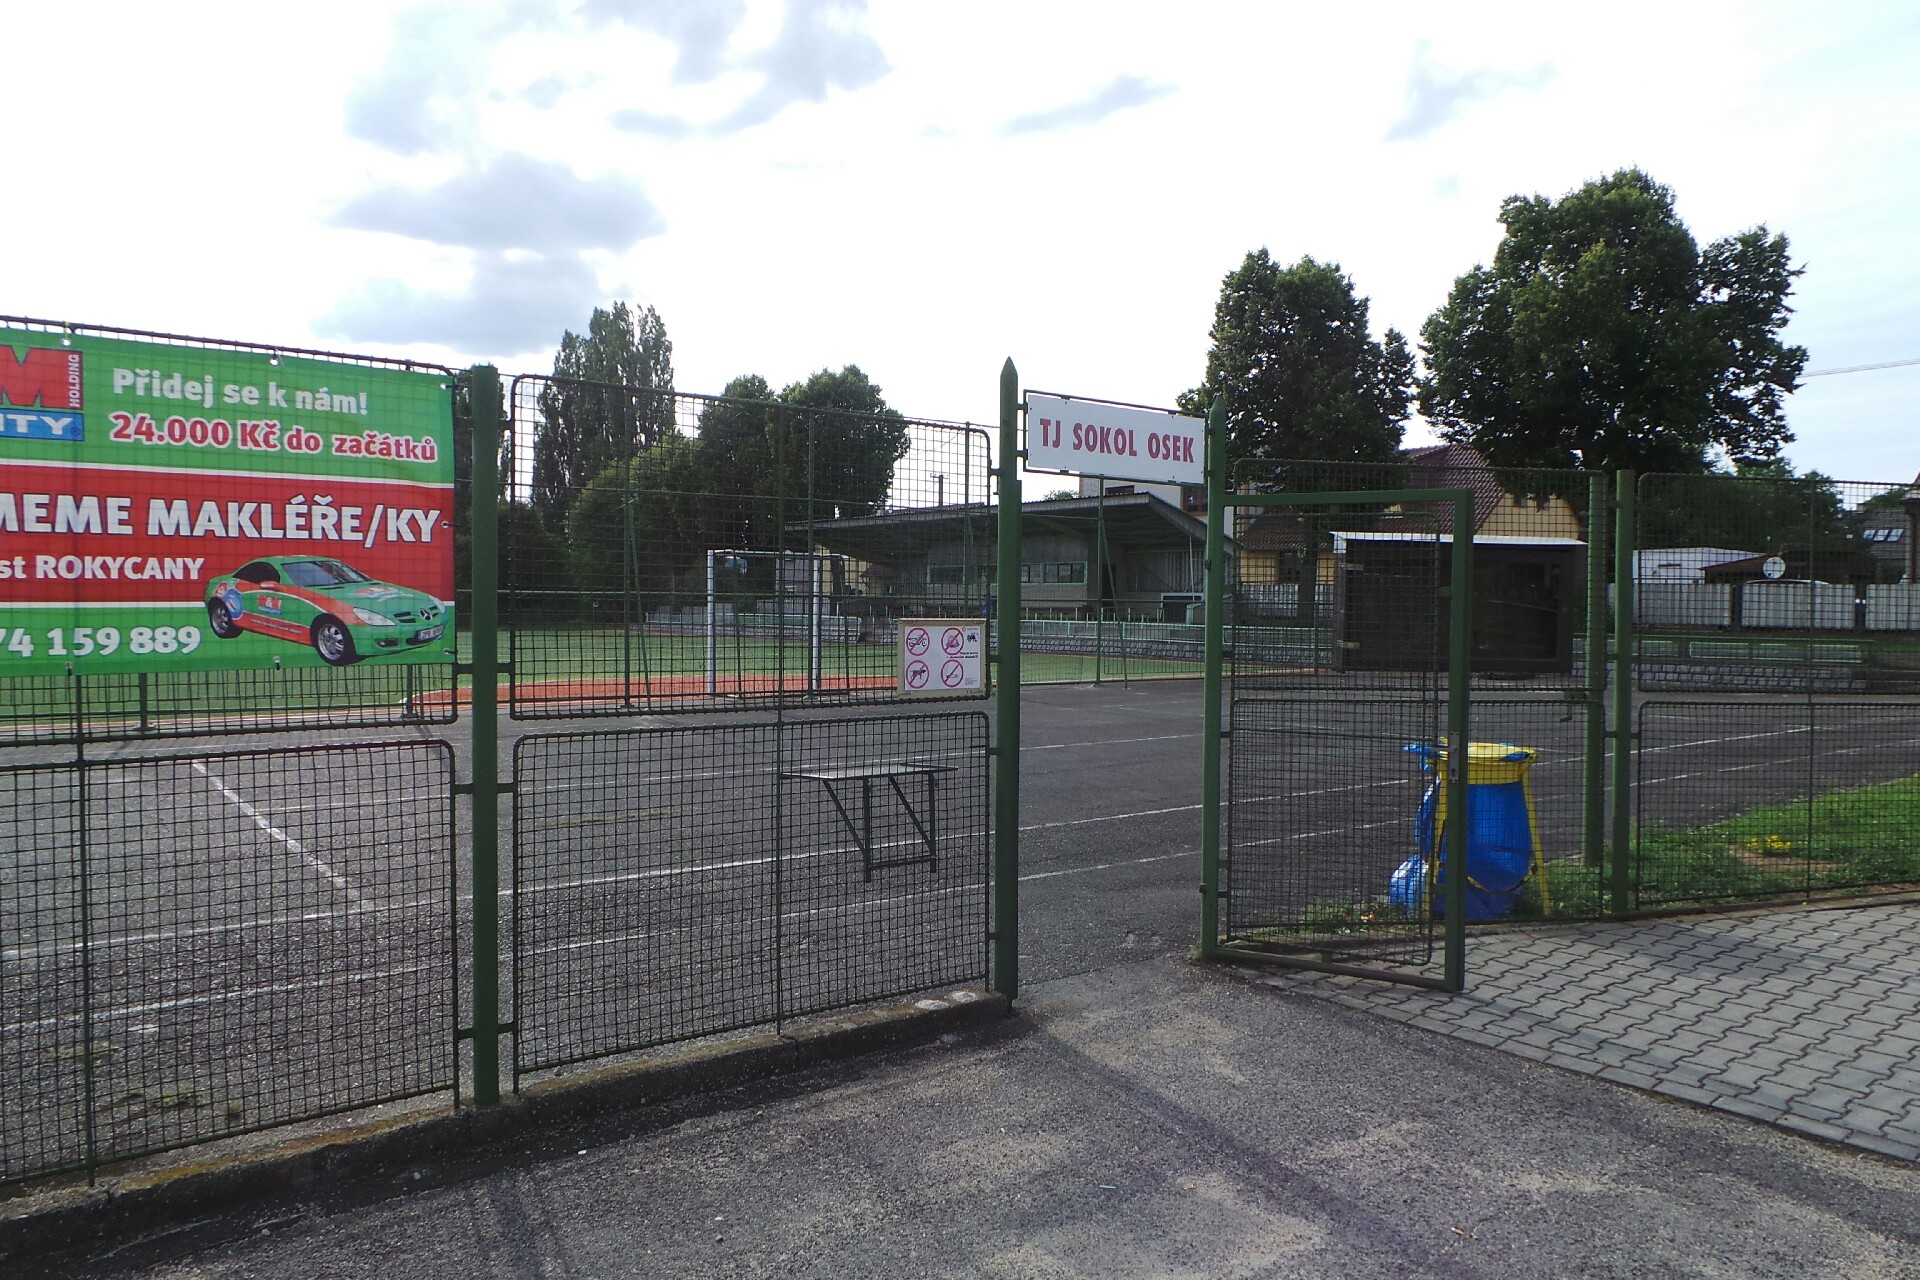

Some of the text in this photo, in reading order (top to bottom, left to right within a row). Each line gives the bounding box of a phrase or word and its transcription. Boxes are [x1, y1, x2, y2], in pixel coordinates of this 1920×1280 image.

[68, 354, 80, 407] HOLDING
[113, 368, 368, 415] Přidej se k nám!
[110, 412, 438, 463] 24.000 Kč do začátků
[1040, 418, 1194, 463] TJ SOKOL OSEK
[148, 494, 440, 548] MAKLÉŘE/KY
[35, 555, 204, 580] ROKYCANY
[47, 626, 121, 657] 159
[129, 626, 200, 653] 889
